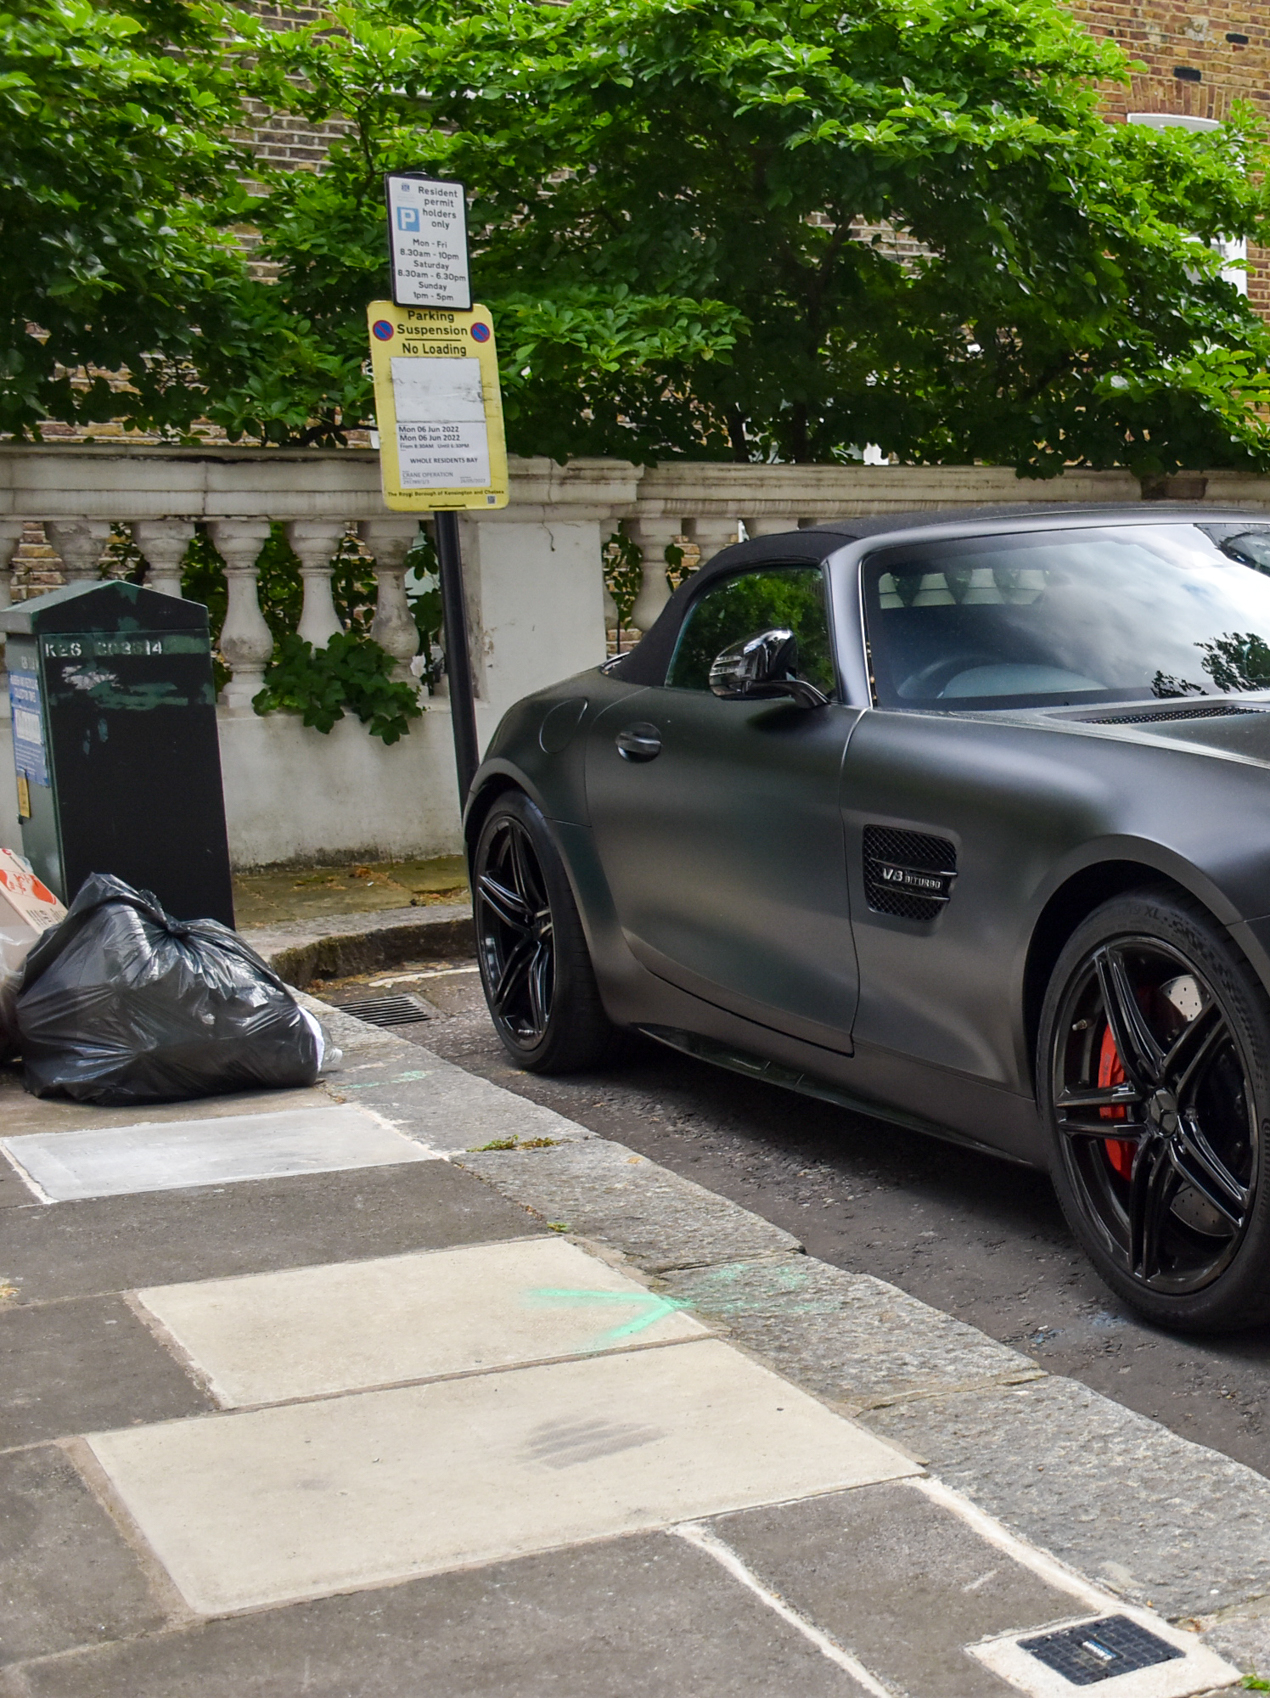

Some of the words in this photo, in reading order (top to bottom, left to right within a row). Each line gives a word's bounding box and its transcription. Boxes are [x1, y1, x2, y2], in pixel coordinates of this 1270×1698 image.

[418, 186, 458, 198] Resident
[424, 198, 454, 208] permit
[422, 208, 457, 219] holders
[400, 209, 416, 230] P
[431, 220, 450, 231] only
[412, 238, 430, 247] Mon
[436, 240, 448, 248] Fri
[399, 248, 431, 258] 8.30am
[438, 251, 460, 261] 10pm
[413, 260, 449, 271] Saturday
[397, 269, 429, 279] 8.30am
[435, 272, 467, 282] 6.30pm
[418, 281, 447, 292] Sunday
[413, 291, 429, 300] 1pm
[436, 292, 454, 301] 5pm
[407, 310, 455, 323] Parking
[397, 323, 468, 336] Suspension
[402, 343, 419, 354] No
[422, 343, 467, 357] Loading
[399, 434, 417, 442] Mon
[429, 434, 442, 442] Jun
[443, 434, 461, 442] 2022
[882, 868, 904, 882] V8
[904, 875, 941, 889] BITURBO
